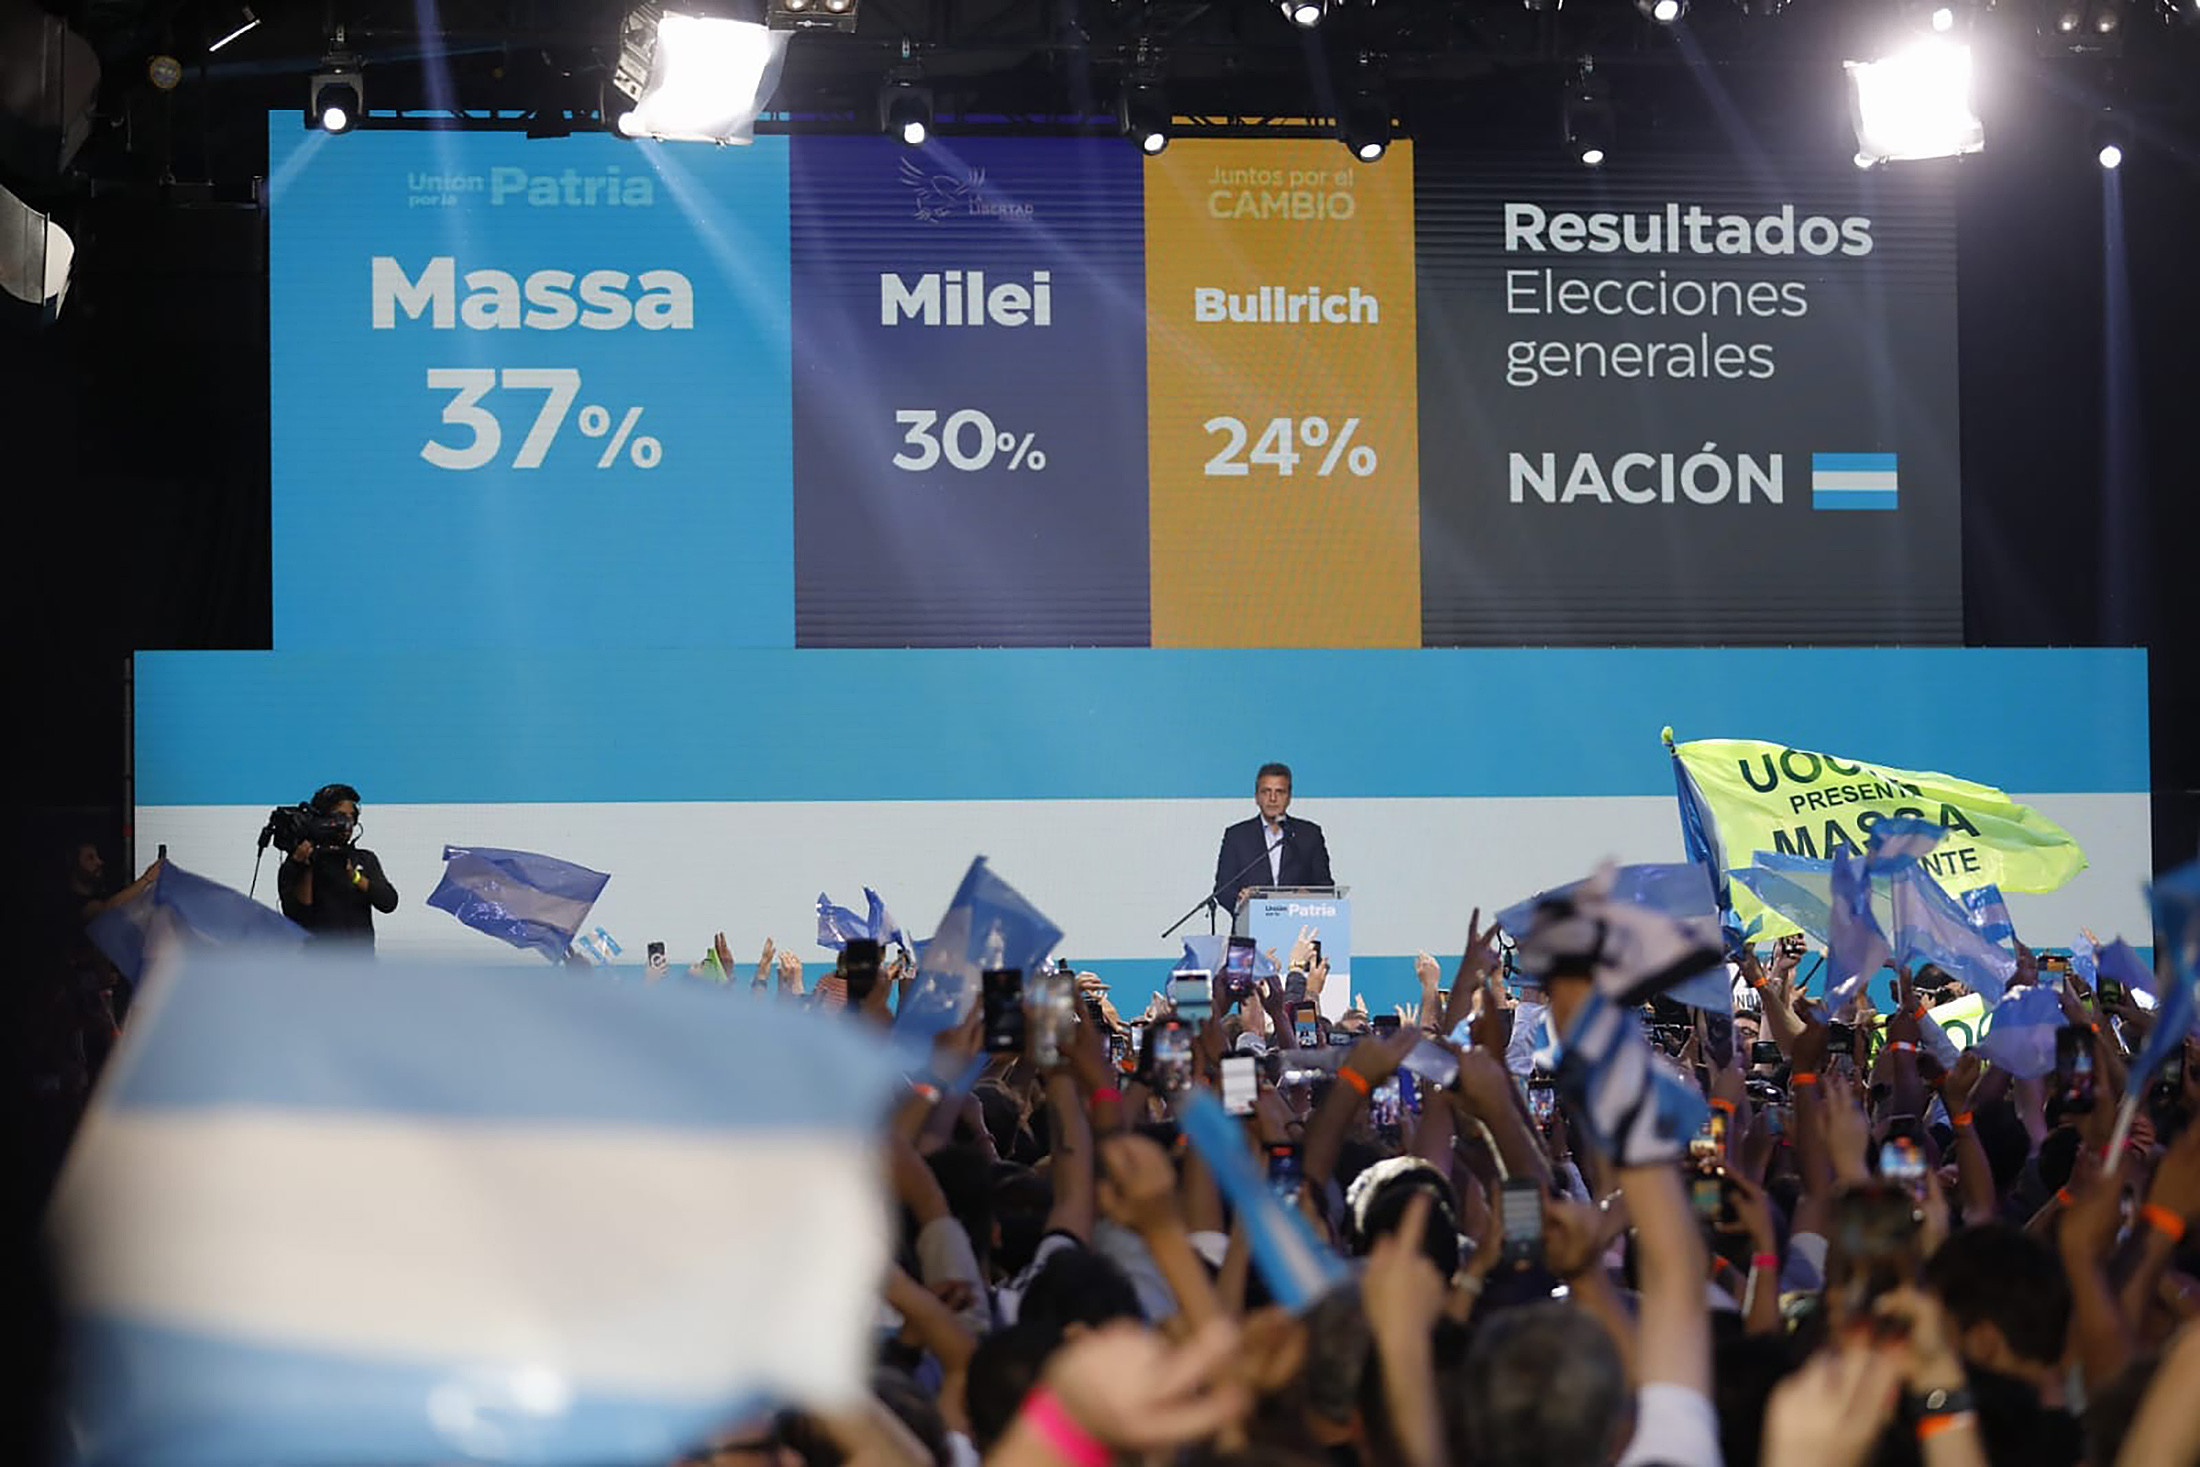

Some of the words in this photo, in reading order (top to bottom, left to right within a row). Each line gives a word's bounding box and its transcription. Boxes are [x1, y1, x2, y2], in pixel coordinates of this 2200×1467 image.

[490, 165, 654, 206] Patria
[1209, 166, 1284, 186] Juntos
[1290, 170, 1331, 188] por
[1207, 189, 1356, 221] CAMBIO
[1503, 202, 1875, 257] Resultados
[371, 256, 694, 331] Massa
[881, 270, 1052, 328] Milei
[1194, 286, 1379, 324] Bullrich
[1506, 268, 1808, 317] Elecciones
[1506, 332, 1775, 388] generales
[419, 367, 663, 471] 37%
[892, 408, 1047, 472] 30%
[1203, 416, 1378, 478] 24%
[1508, 440, 1784, 504] NACIÓN
[1288, 903, 1337, 917] Patria
